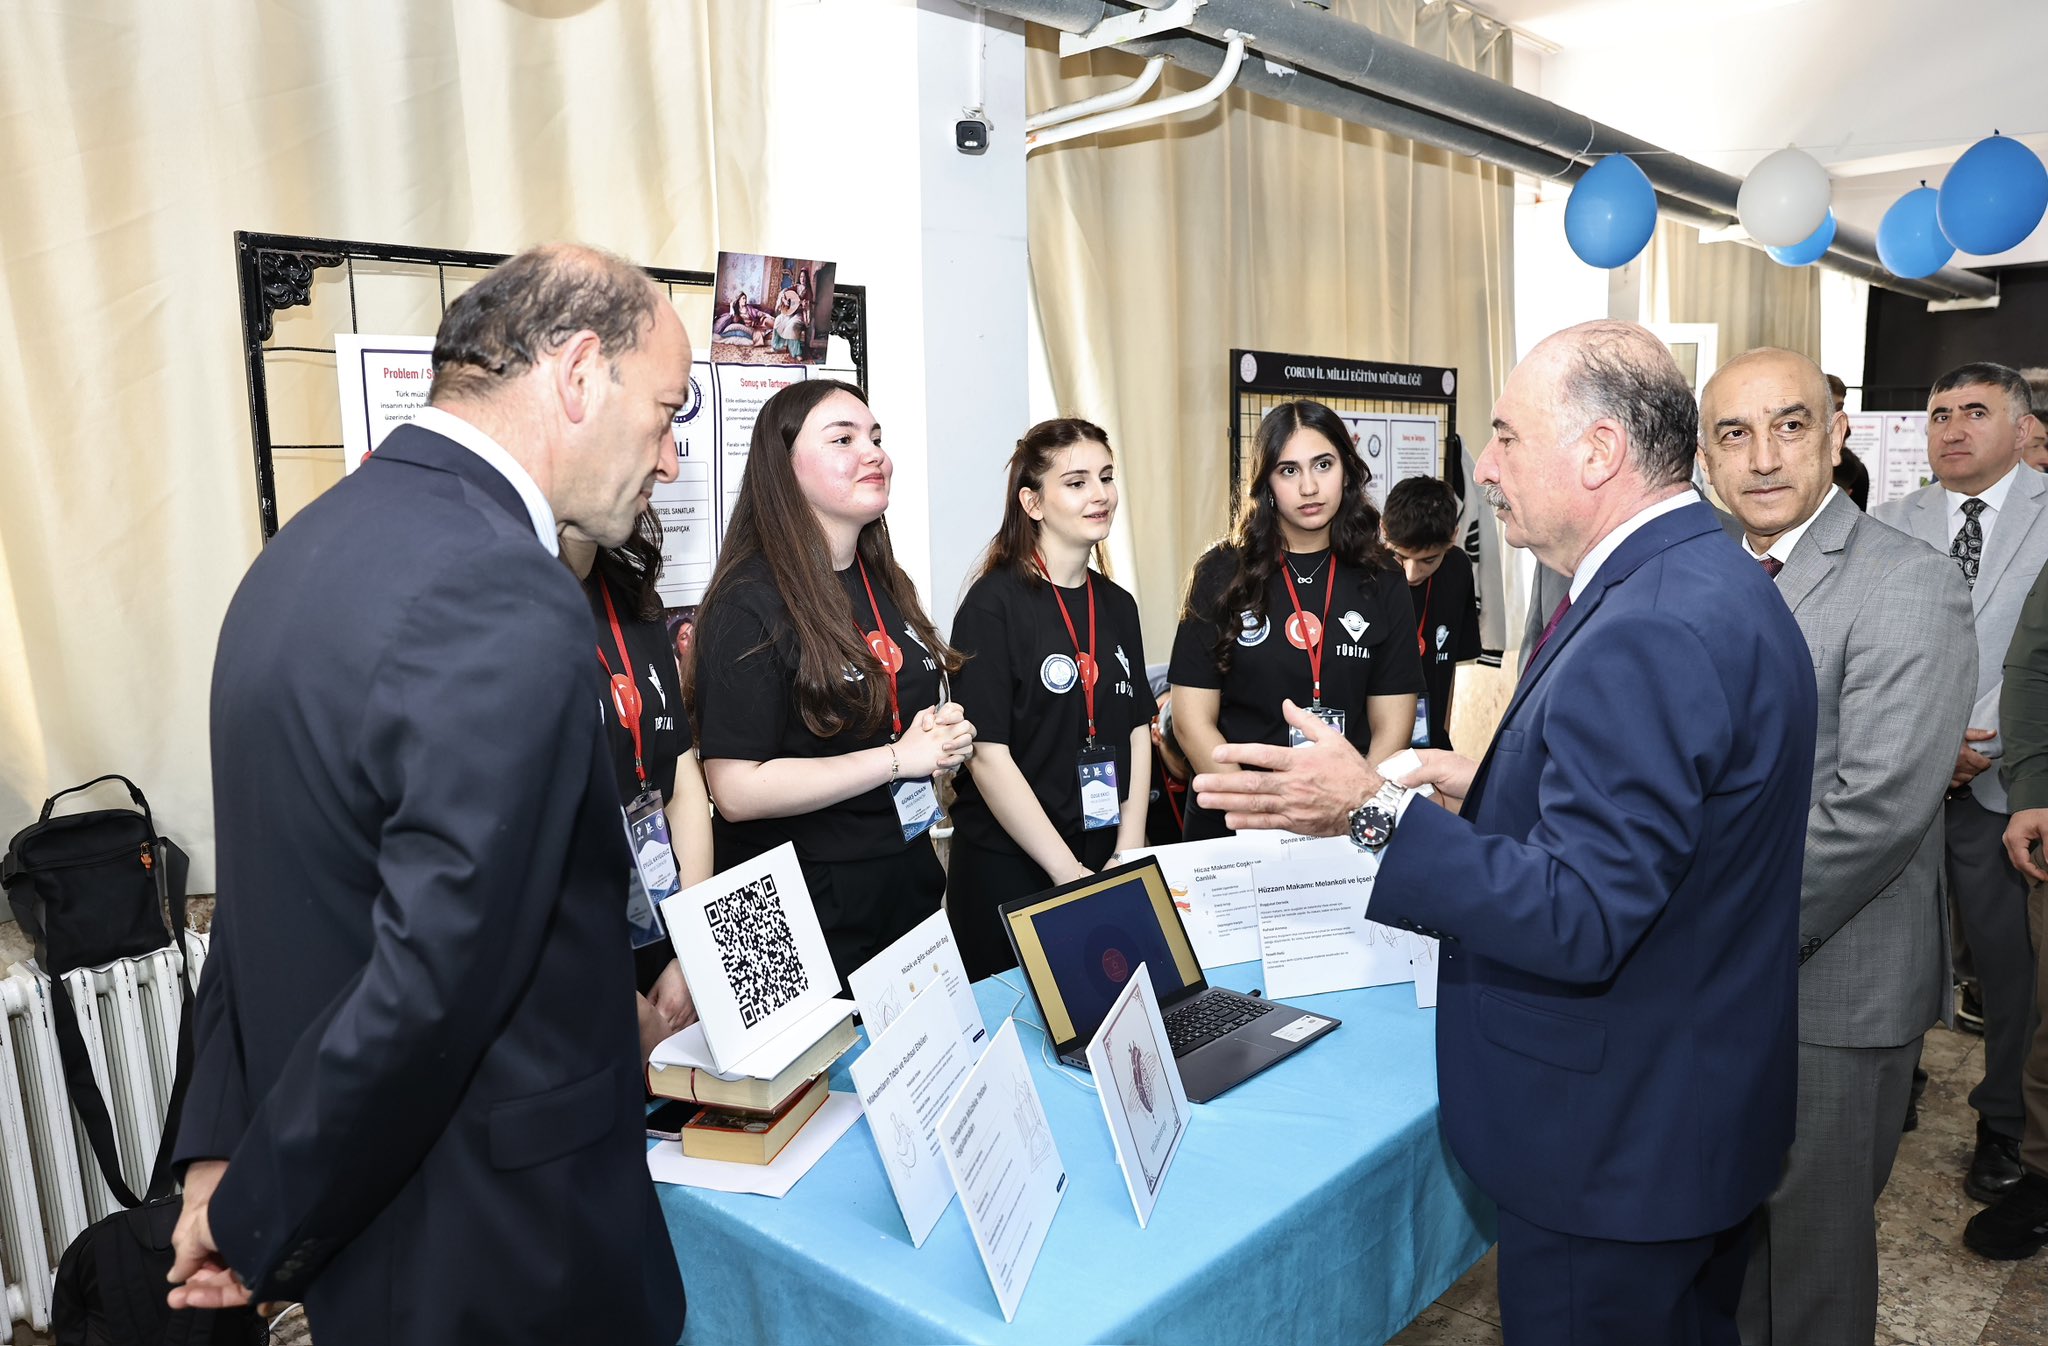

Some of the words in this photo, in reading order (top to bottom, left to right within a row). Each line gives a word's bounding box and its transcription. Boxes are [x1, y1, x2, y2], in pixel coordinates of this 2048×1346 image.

[383, 367, 419, 379] Problem
[1284, 365, 1315, 379] ÇORUM
[1316, 365, 1325, 379] İL
[1326, 367, 1350, 381] MİLLİ
[1350, 369, 1378, 383] EĞİTİM
[1379, 371, 1422, 386] MÜDÜRLÜĞÜ
[740, 378, 759, 389] Sonuç
[760, 380, 767, 388] ve
[396, 390, 409, 398] Türk
[672, 507, 696, 515] SANATLAR
[1258, 885, 1285, 894] Hüzzam
[1315, 878, 1347, 888] Melankoli
[1356, 874, 1373, 885] İçsel
